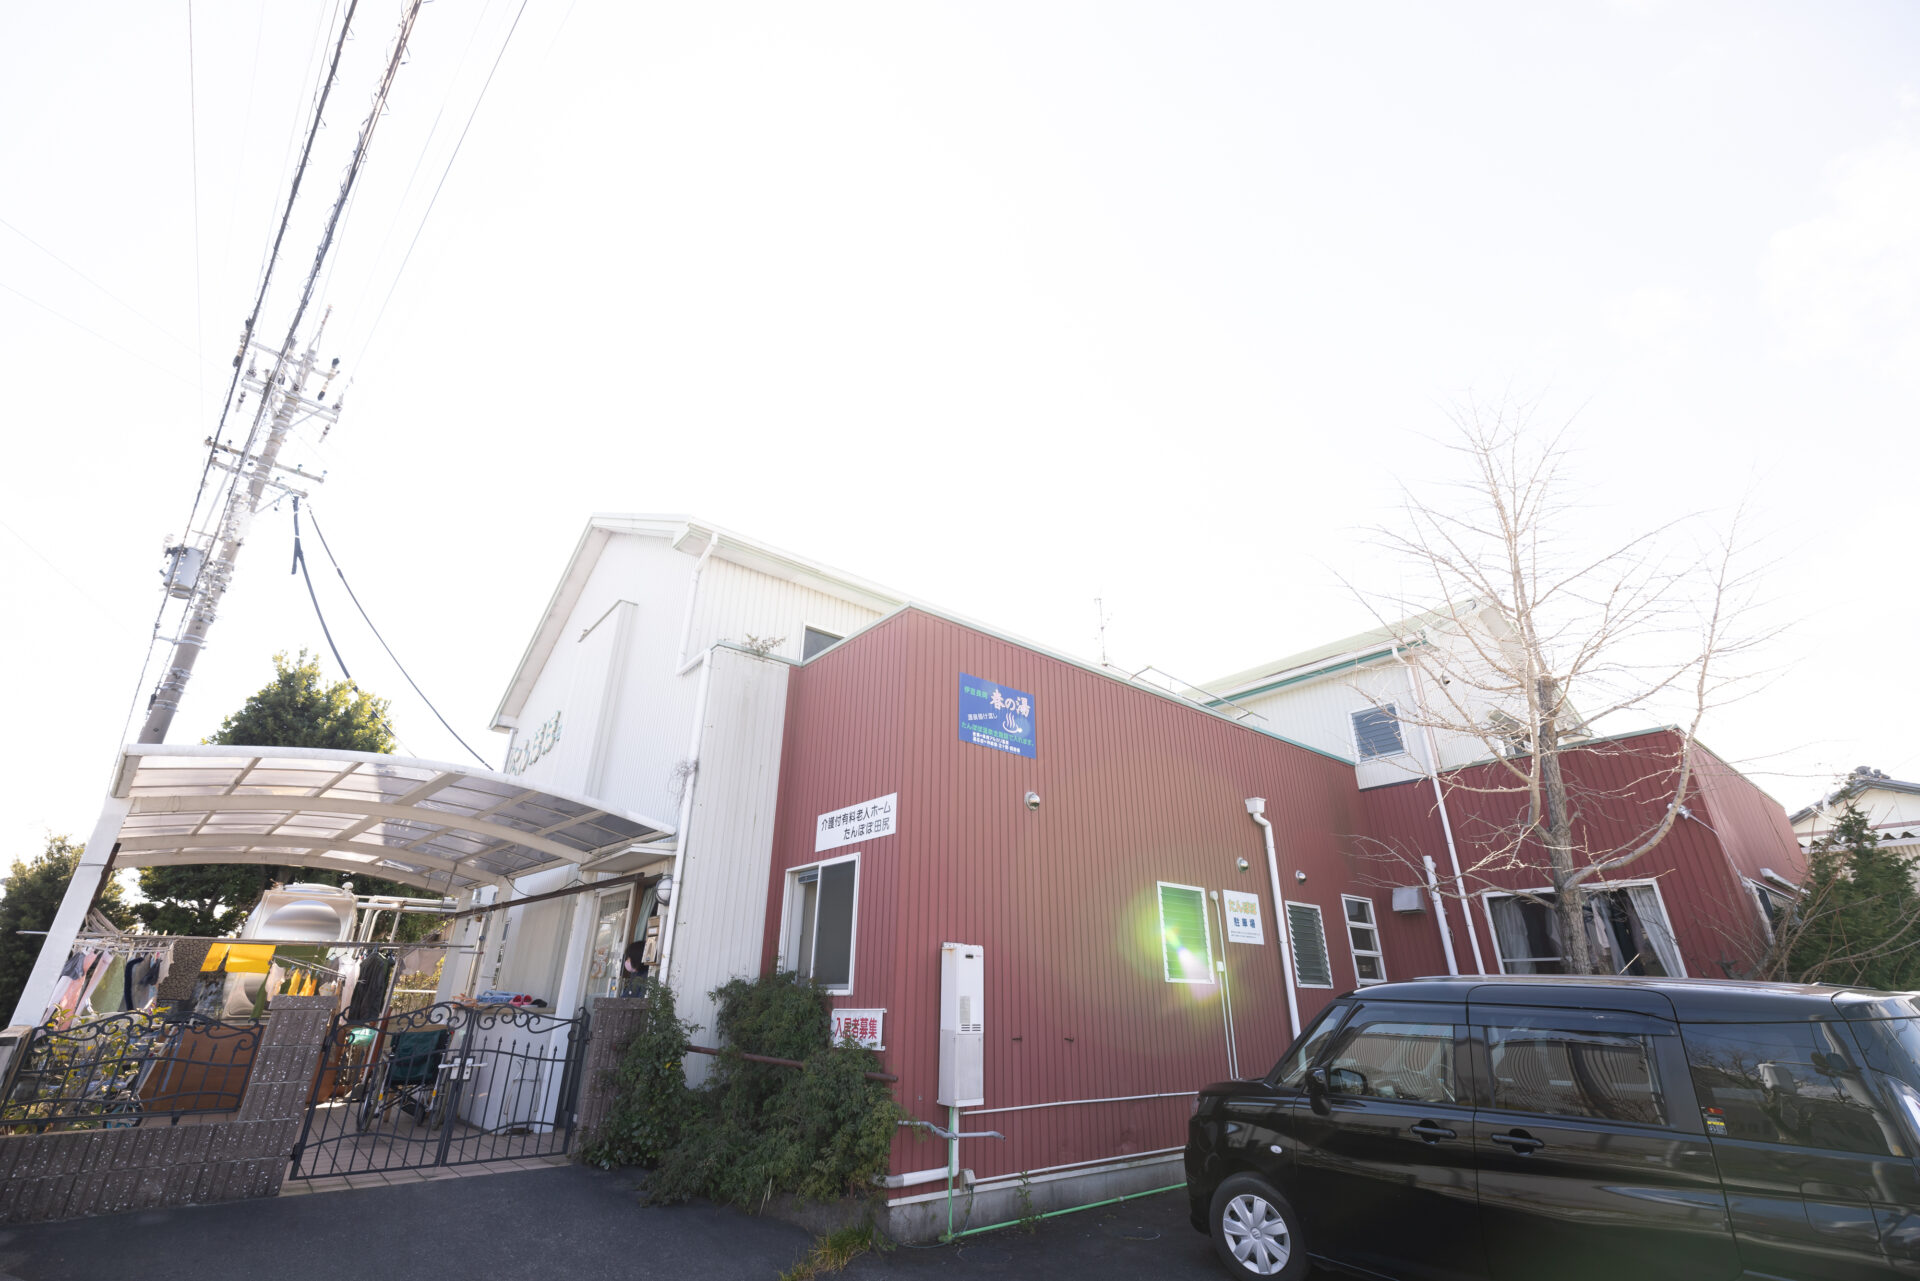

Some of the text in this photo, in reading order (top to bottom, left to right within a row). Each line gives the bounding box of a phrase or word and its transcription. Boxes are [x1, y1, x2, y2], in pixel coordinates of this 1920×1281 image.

[990, 688, 1031, 718] 春の湯
[821, 801, 891, 831] 介護付有料老人ホーム
[843, 817, 890, 840] たんぽぽ田尻
[834, 1017, 878, 1040] 入居者募集
